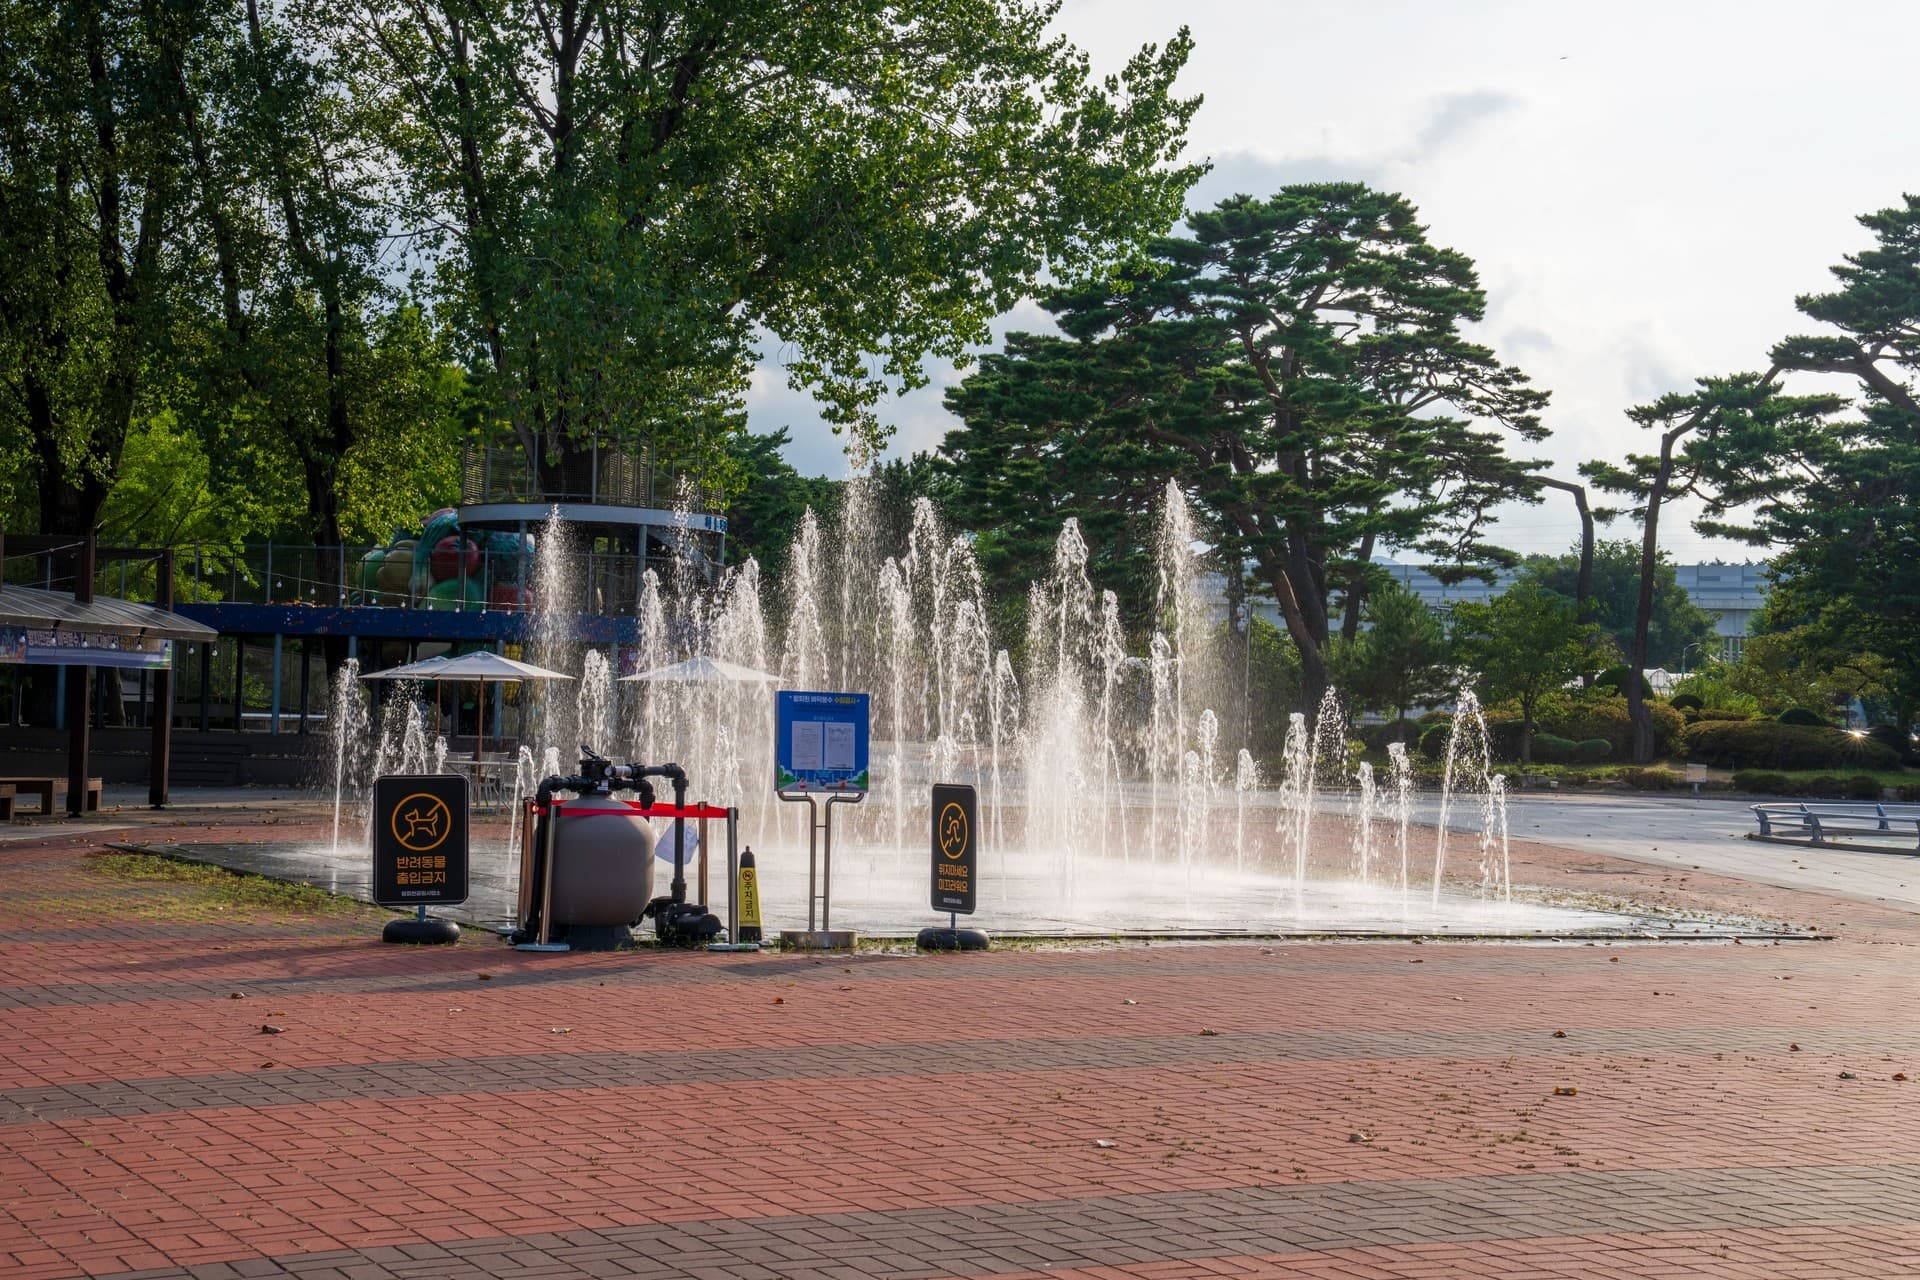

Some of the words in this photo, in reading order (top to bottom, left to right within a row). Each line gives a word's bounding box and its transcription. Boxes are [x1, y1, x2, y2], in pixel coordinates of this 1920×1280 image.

[396, 856, 447, 869] 반려동물
[938, 864, 968, 877] 뛰지마세요
[397, 872, 446, 885] 출입금지
[938, 879, 968, 892] 미끄러워요
[744, 882, 753, 919] 주차금지
